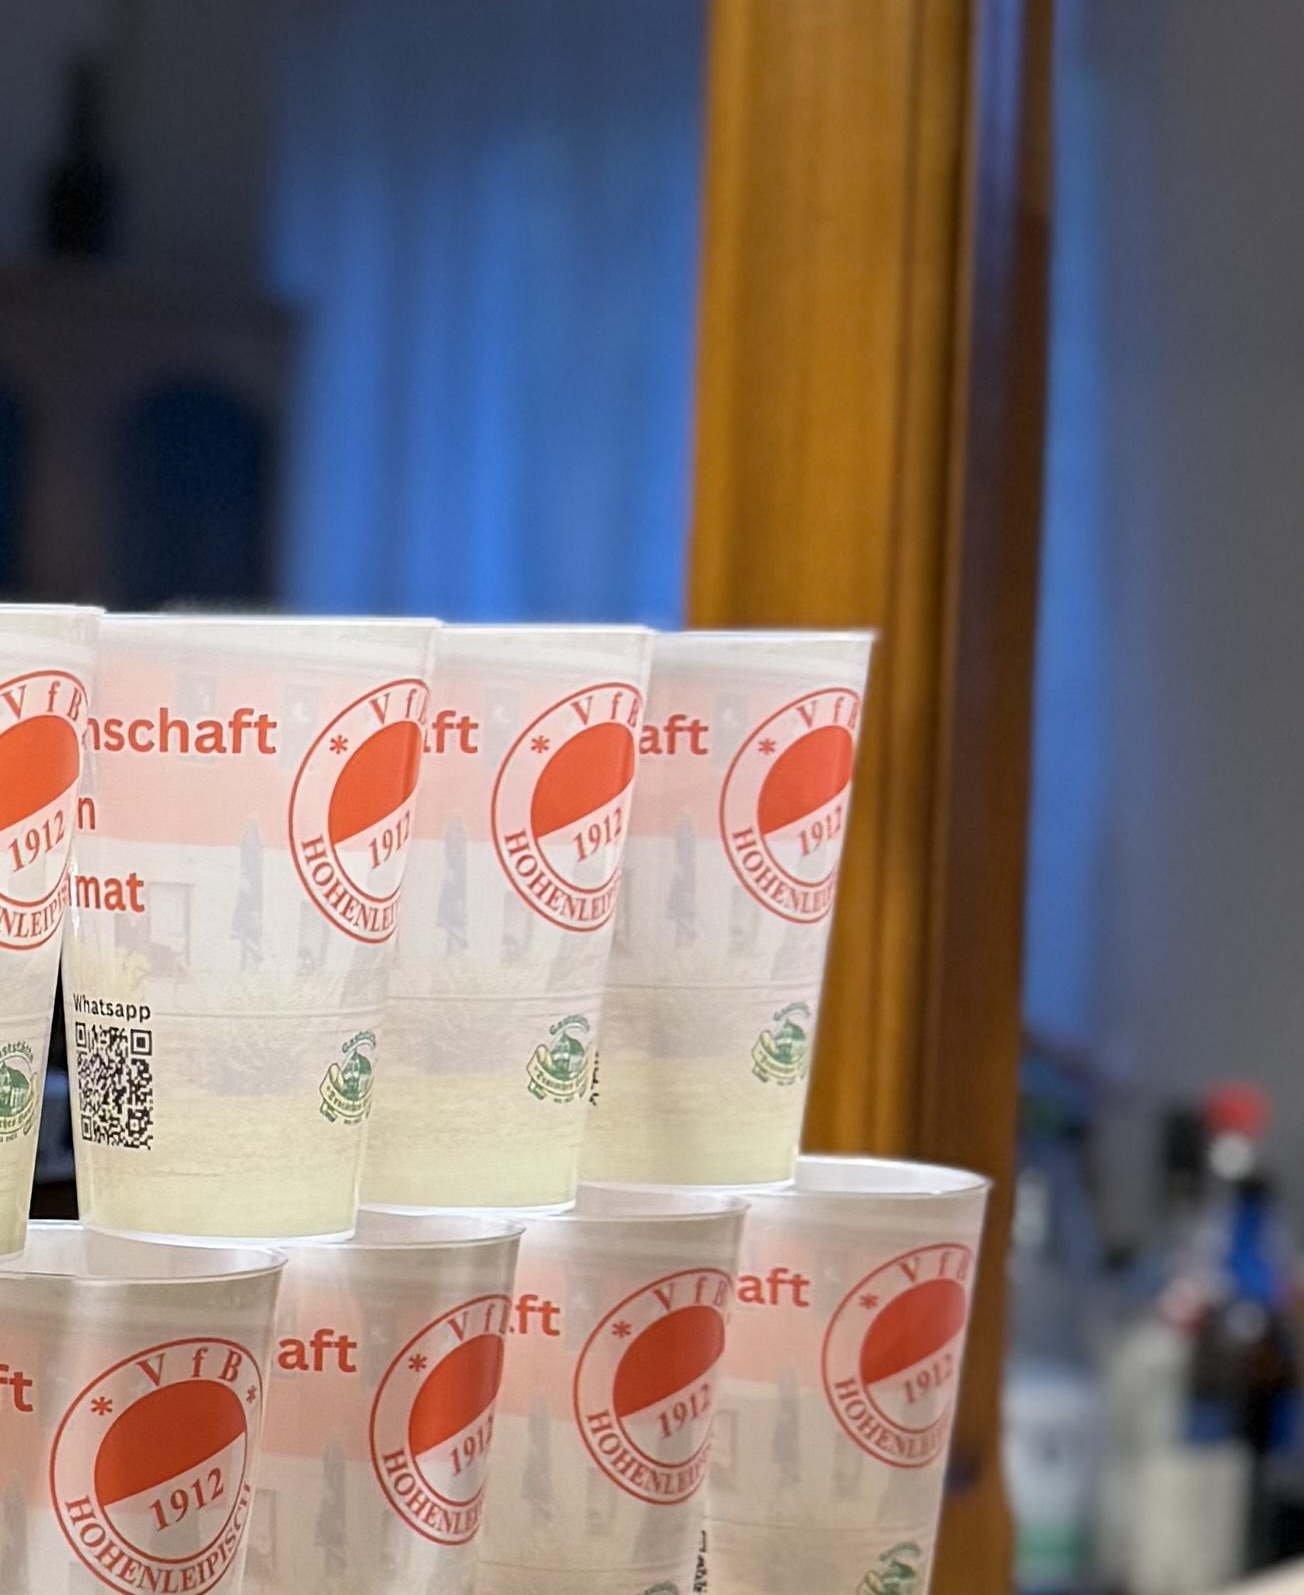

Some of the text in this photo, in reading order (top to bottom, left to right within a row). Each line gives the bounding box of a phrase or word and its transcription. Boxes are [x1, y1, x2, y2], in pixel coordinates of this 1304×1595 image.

[7, 809, 65, 874] 1912
[572, 806, 623, 863] 1912
[72, 993, 152, 1029] Whatsapp
[149, 1467, 225, 1533] 1912
